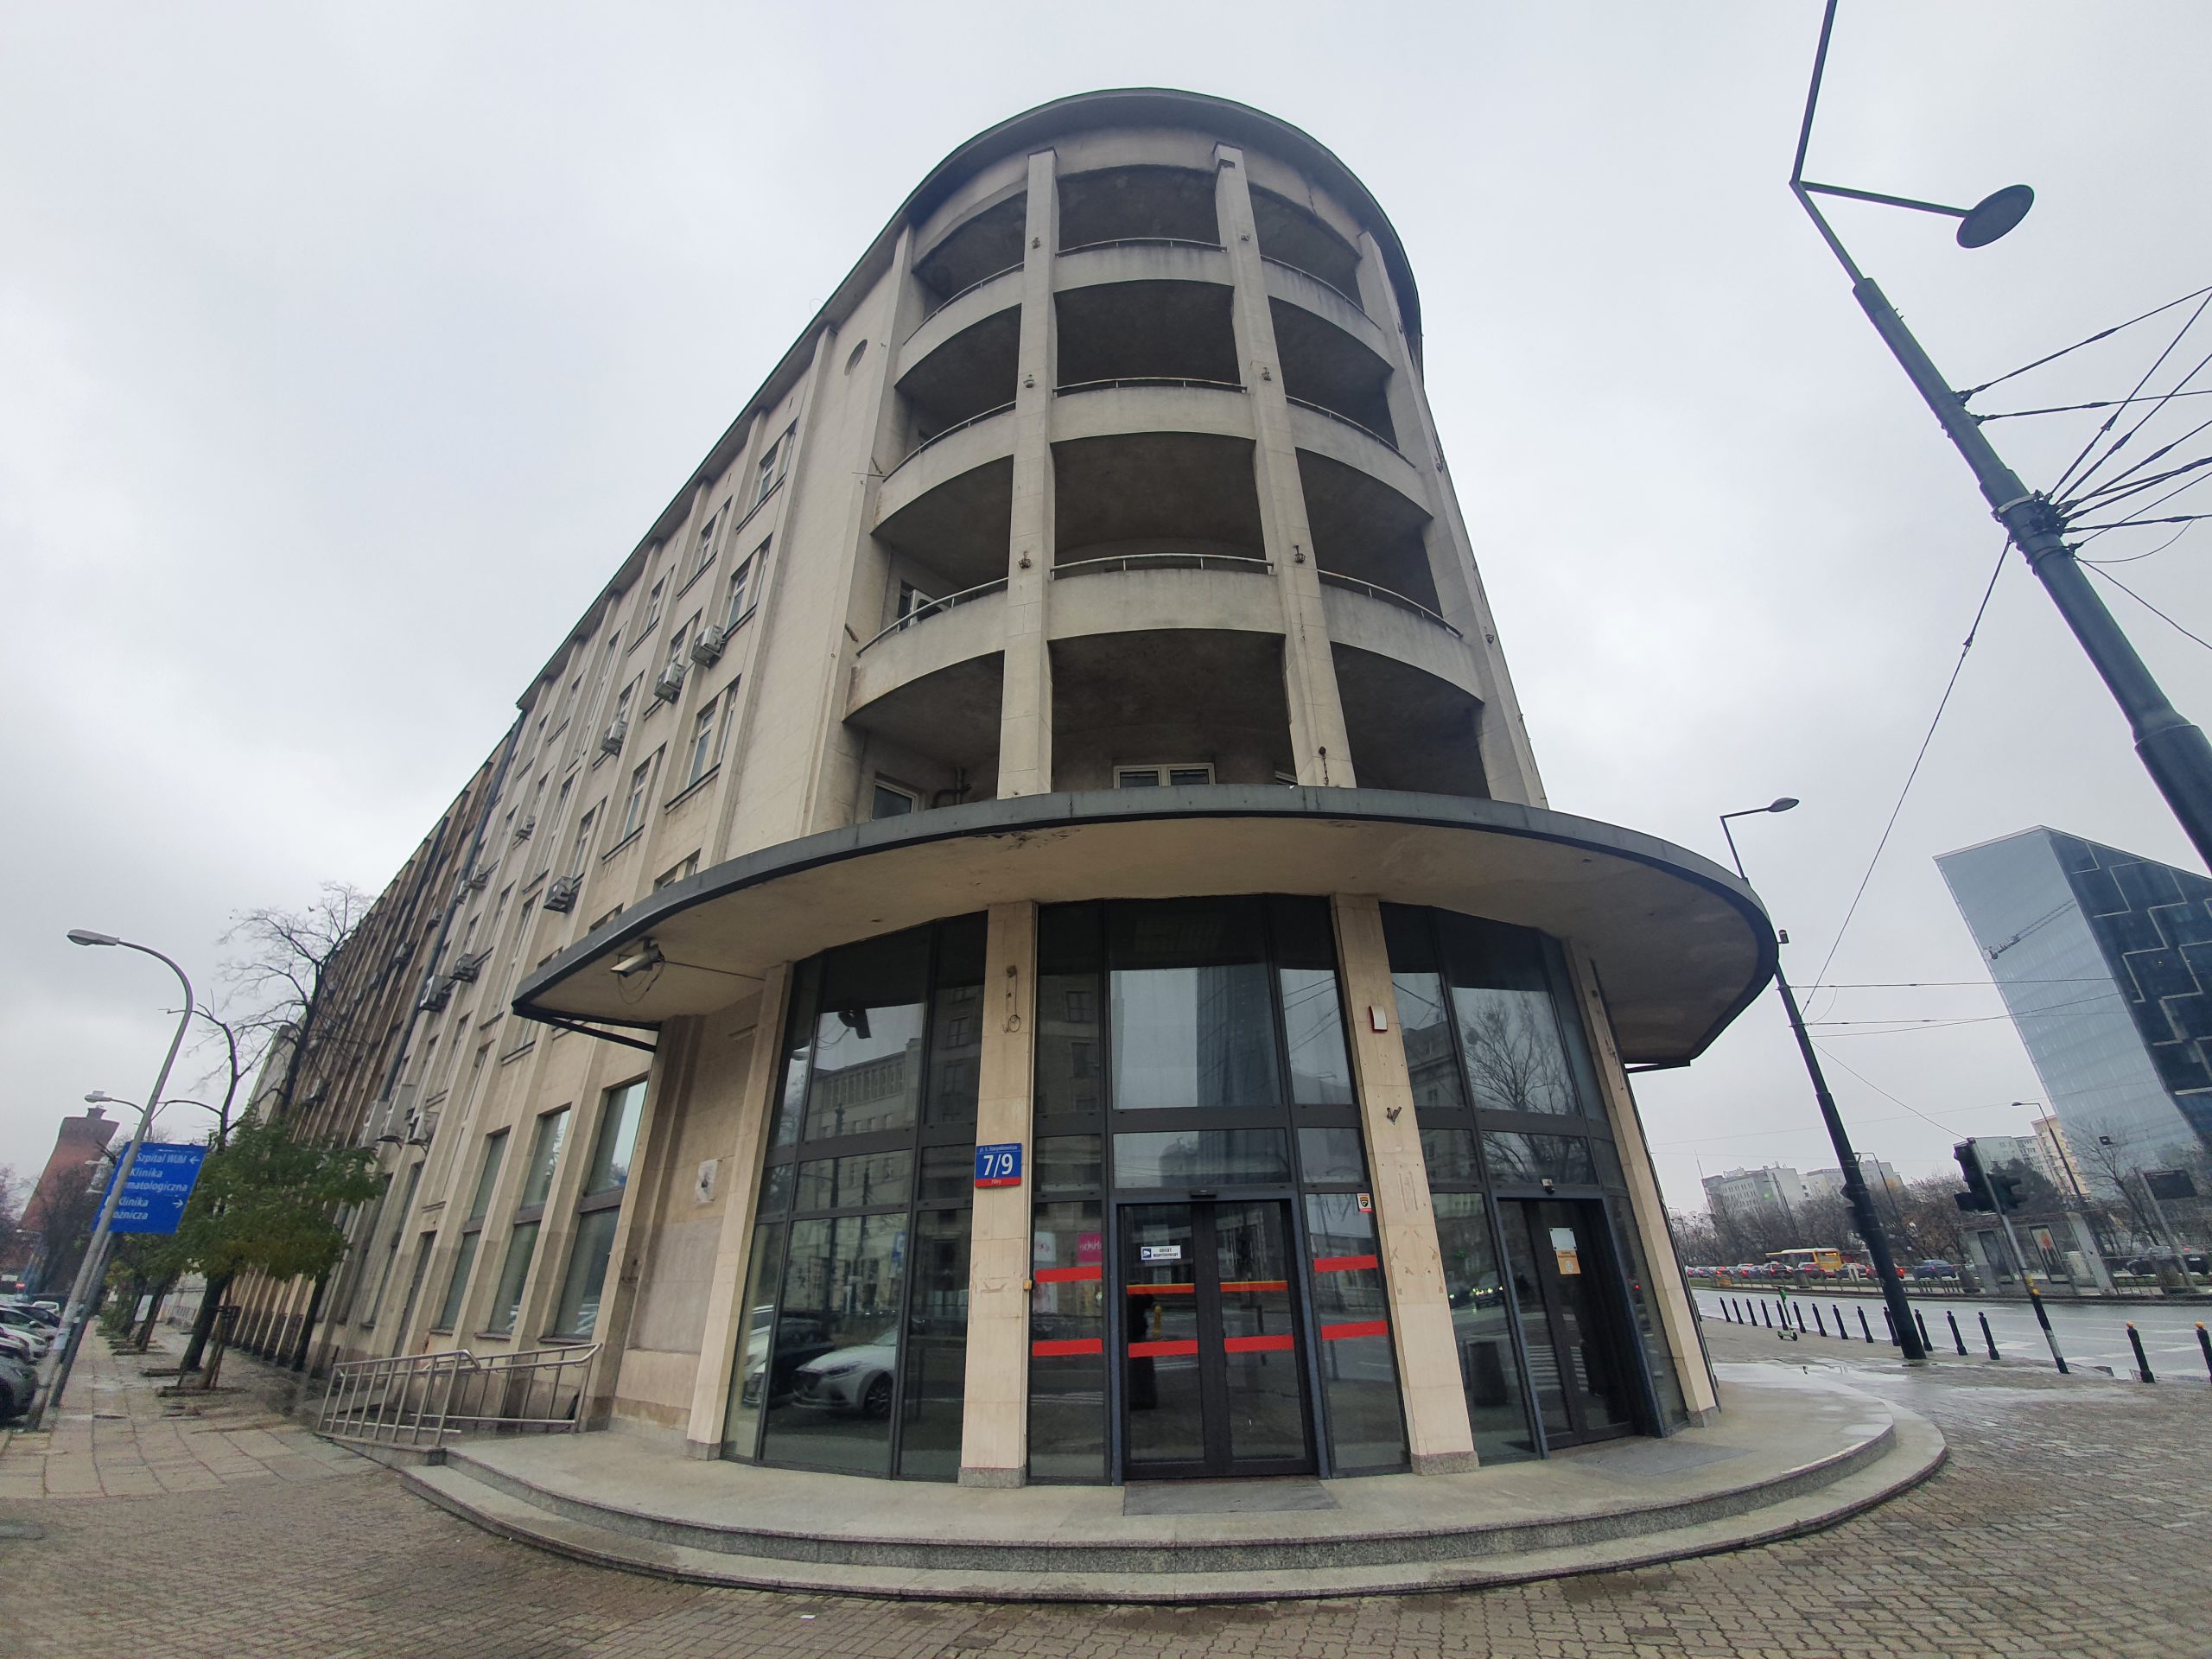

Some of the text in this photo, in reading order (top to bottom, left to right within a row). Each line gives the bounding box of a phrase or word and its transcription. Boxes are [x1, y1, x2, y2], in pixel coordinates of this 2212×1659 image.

[136, 1153, 165, 1164] Szpital
[983, 1153, 1014, 1178] 7/9
[130, 1167, 163, 1178] Klinika
[125, 1181, 188, 1192] matologiczna
